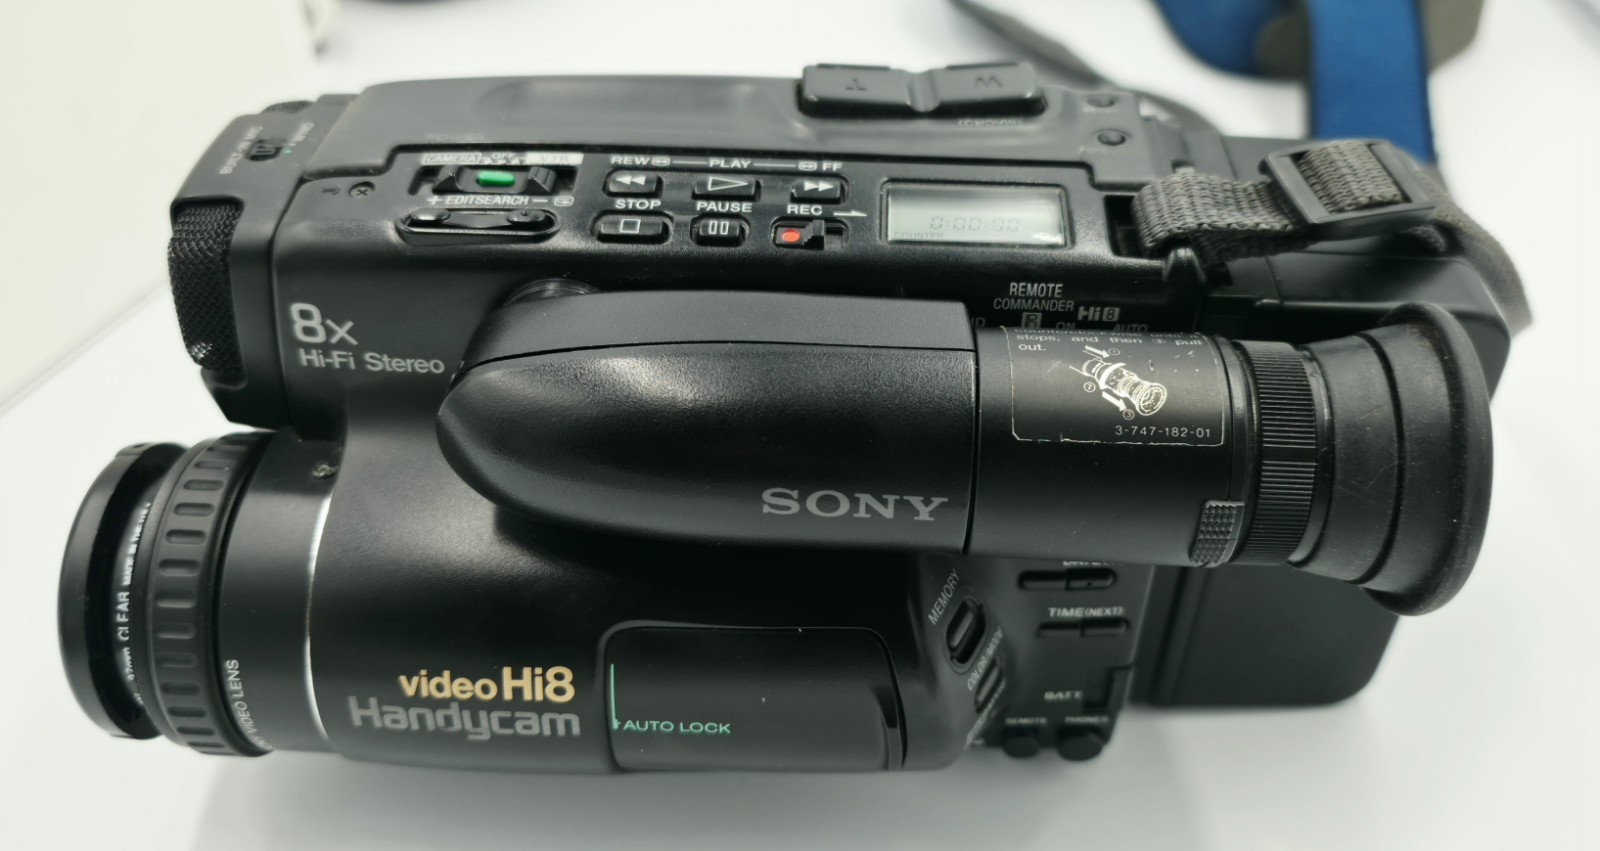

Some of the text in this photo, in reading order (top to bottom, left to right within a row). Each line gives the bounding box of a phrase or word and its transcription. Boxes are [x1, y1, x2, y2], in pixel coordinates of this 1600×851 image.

[611, 156, 650, 166] REW
[709, 158, 751, 169] PLAY
[822, 162, 843, 171] FF
[446, 196, 529, 205] EDITSEARCH
[615, 200, 662, 210] STOP
[697, 203, 752, 214] PAUSE
[787, 204, 823, 215] REC
[1009, 282, 1063, 298] REMOTE
[993, 298, 1074, 312] COMMANDER
[1077, 306, 1120, 322] Hi8
[1018, 343, 1047, 351] out.
[1109, 336, 1143, 345] then
[301, 348, 445, 374] Hi-Fi Stereo
[1115, 425, 1210, 438] 3-747-182-01
[762, 487, 948, 521] SONY
[927, 568, 960, 625] MEMORY
[227, 659, 243, 699] LENS
[399, 666, 575, 702] video Hi8
[348, 696, 581, 741] Handycam
[623, 719, 731, 734] AUTO LOCK
